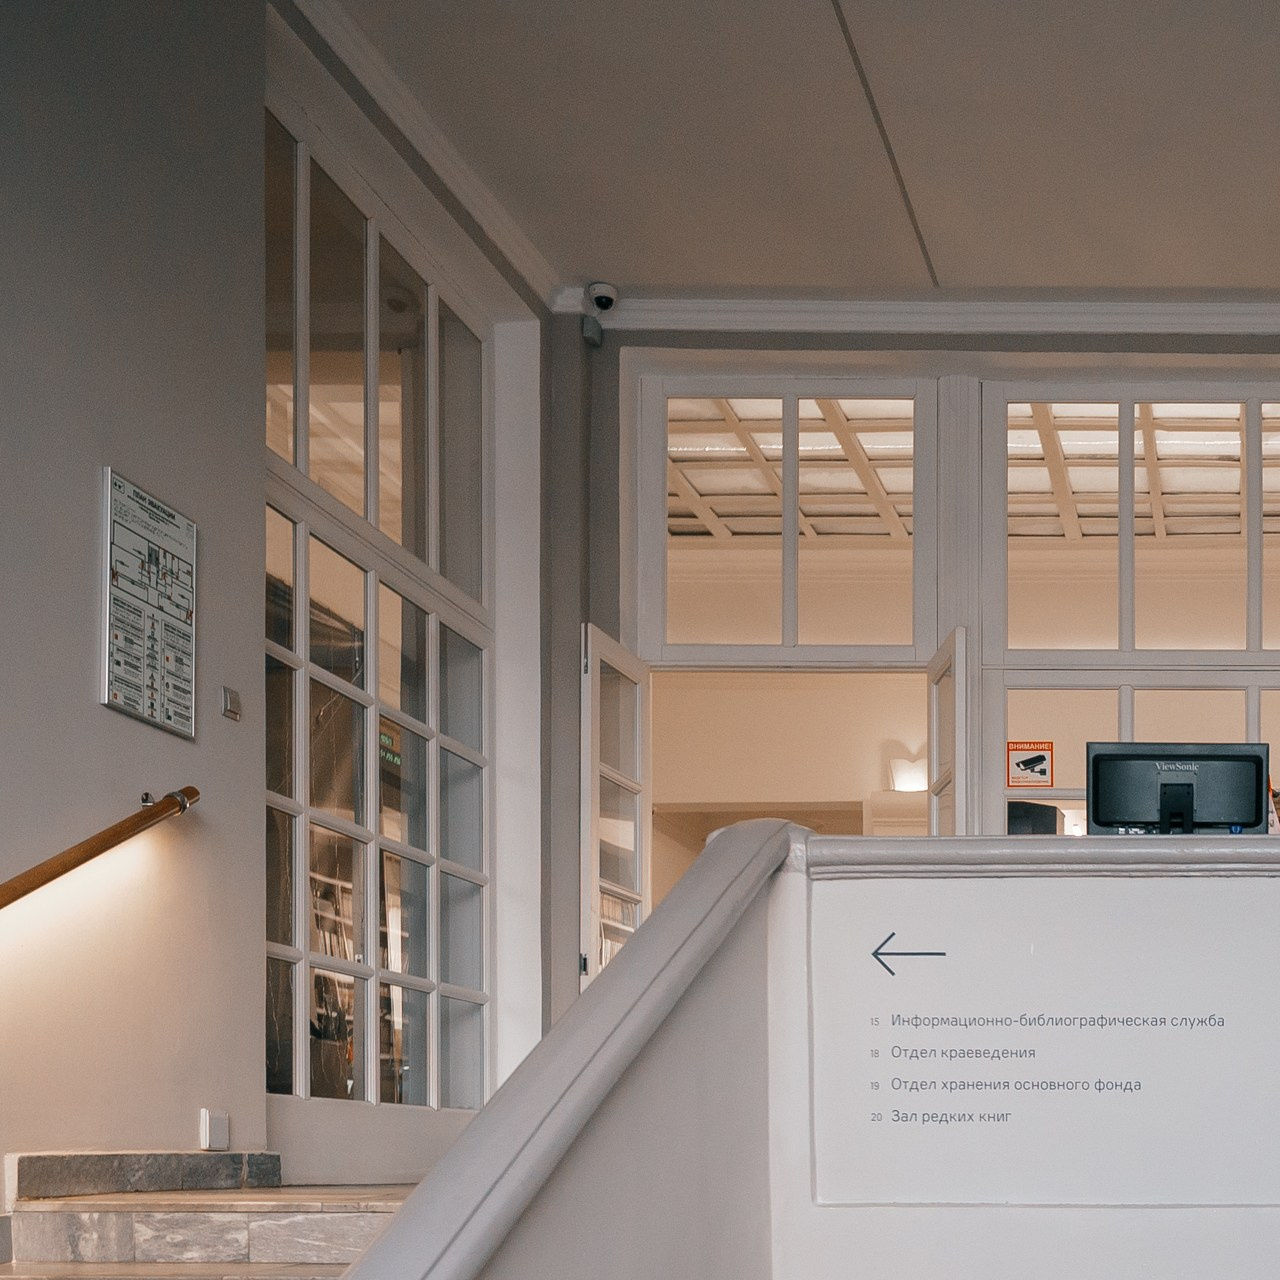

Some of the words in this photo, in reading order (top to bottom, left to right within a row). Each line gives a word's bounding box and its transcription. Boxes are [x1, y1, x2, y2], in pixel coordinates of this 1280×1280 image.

[1155, 761, 1200, 771] ViewSonic
[869, 1017, 880, 1027] 15
[891, 1012, 1167, 1031] Информационно-библиографическая
[1170, 1013, 1226, 1031] служба
[869, 1048, 880, 1059] 18
[890, 1045, 937, 1061] Отдел
[940, 1048, 1036, 1062] краеведения
[869, 1080, 880, 1091] 19
[890, 1076, 937, 1093] Отдел
[940, 1079, 1010, 1094] хранения
[1013, 1079, 1091, 1092] основного
[1093, 1076, 1142, 1094] фонда
[870, 1112, 883, 1122] 20
[890, 1109, 918, 1123] Зал
[921, 1111, 975, 1126] редких
[978, 1111, 1013, 1123] книг
